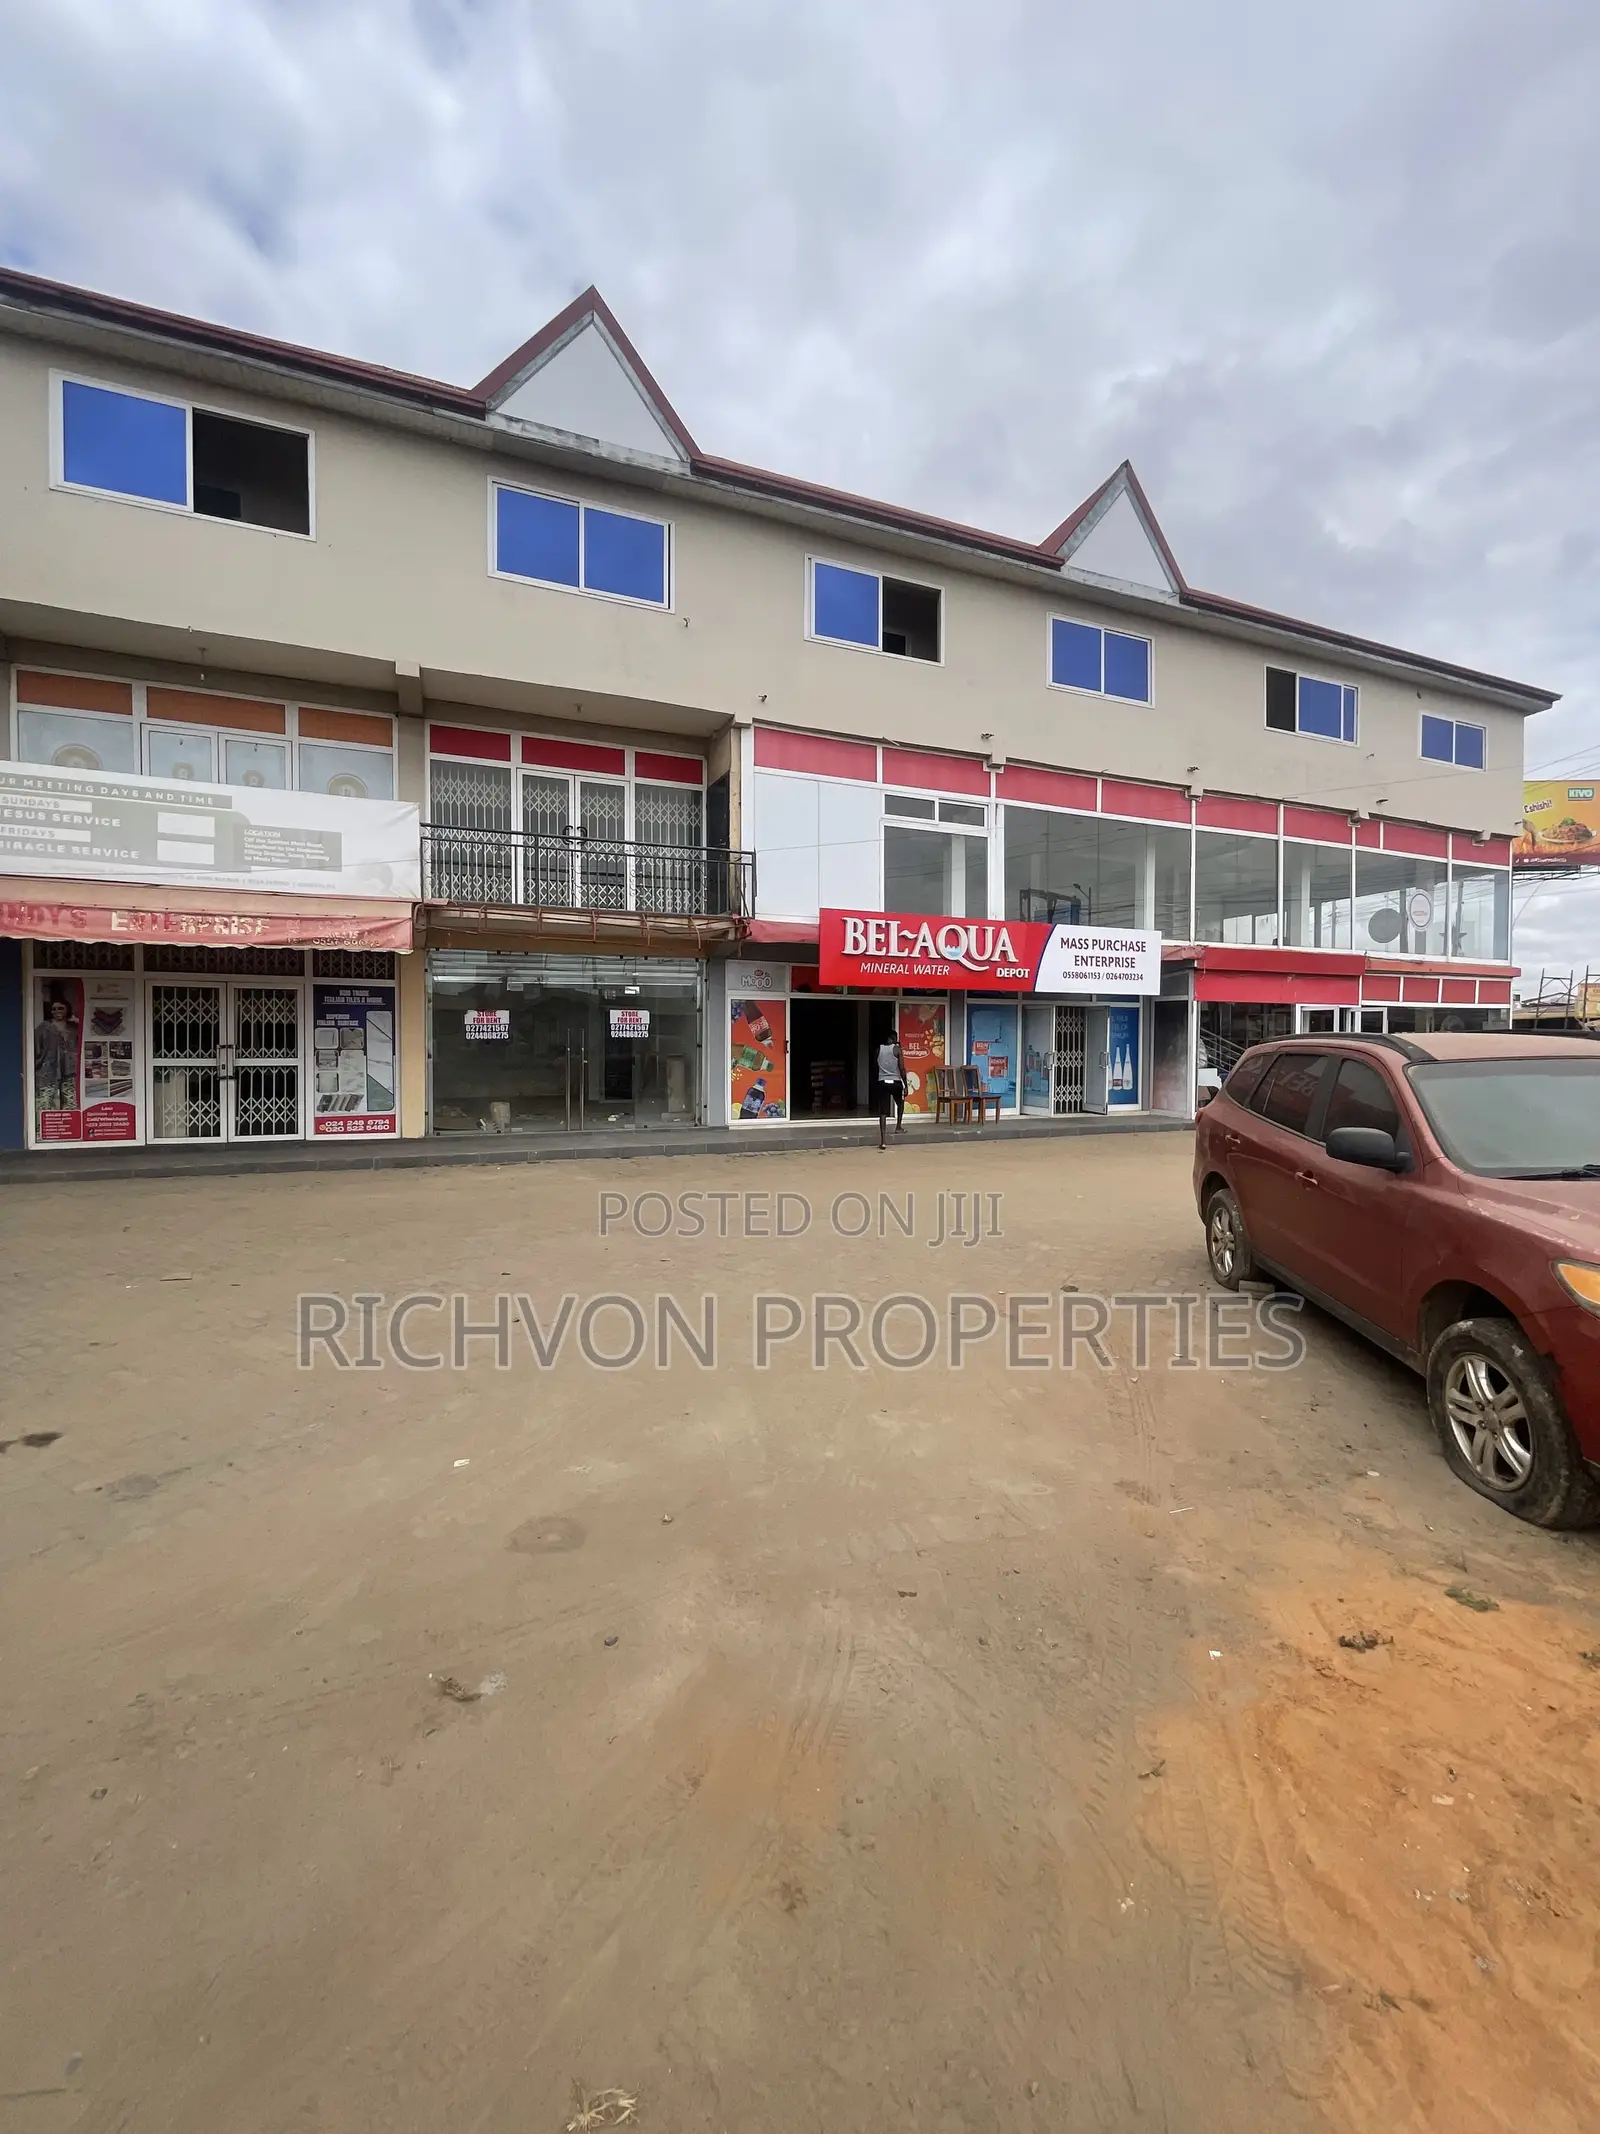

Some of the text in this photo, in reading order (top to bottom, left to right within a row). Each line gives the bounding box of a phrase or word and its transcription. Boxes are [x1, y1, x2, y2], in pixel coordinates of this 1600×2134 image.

[23, 779, 94, 793] MEETING
[100, 787, 139, 798] DAYS
[144, 791, 174, 801] AND
[180, 794, 213, 805] TIME
[2, 796, 60, 808] SUNDAYS
[0, 808, 121, 827] ESUS SERVICE
[1, 826, 55, 837] FRIDAYS
[71, 846, 139, 859] SERVICE
[1060, 937, 1147, 953] MASS PURCHASE
[1074, 955, 1136, 969] ENTERPRISE
[860, 962, 950, 976] MINERAL WATER
[996, 968, 1030, 979] DEPOT
[1062, 971, 1101, 980] 0558061153
[1105, 972, 1144, 981] 0264703234
